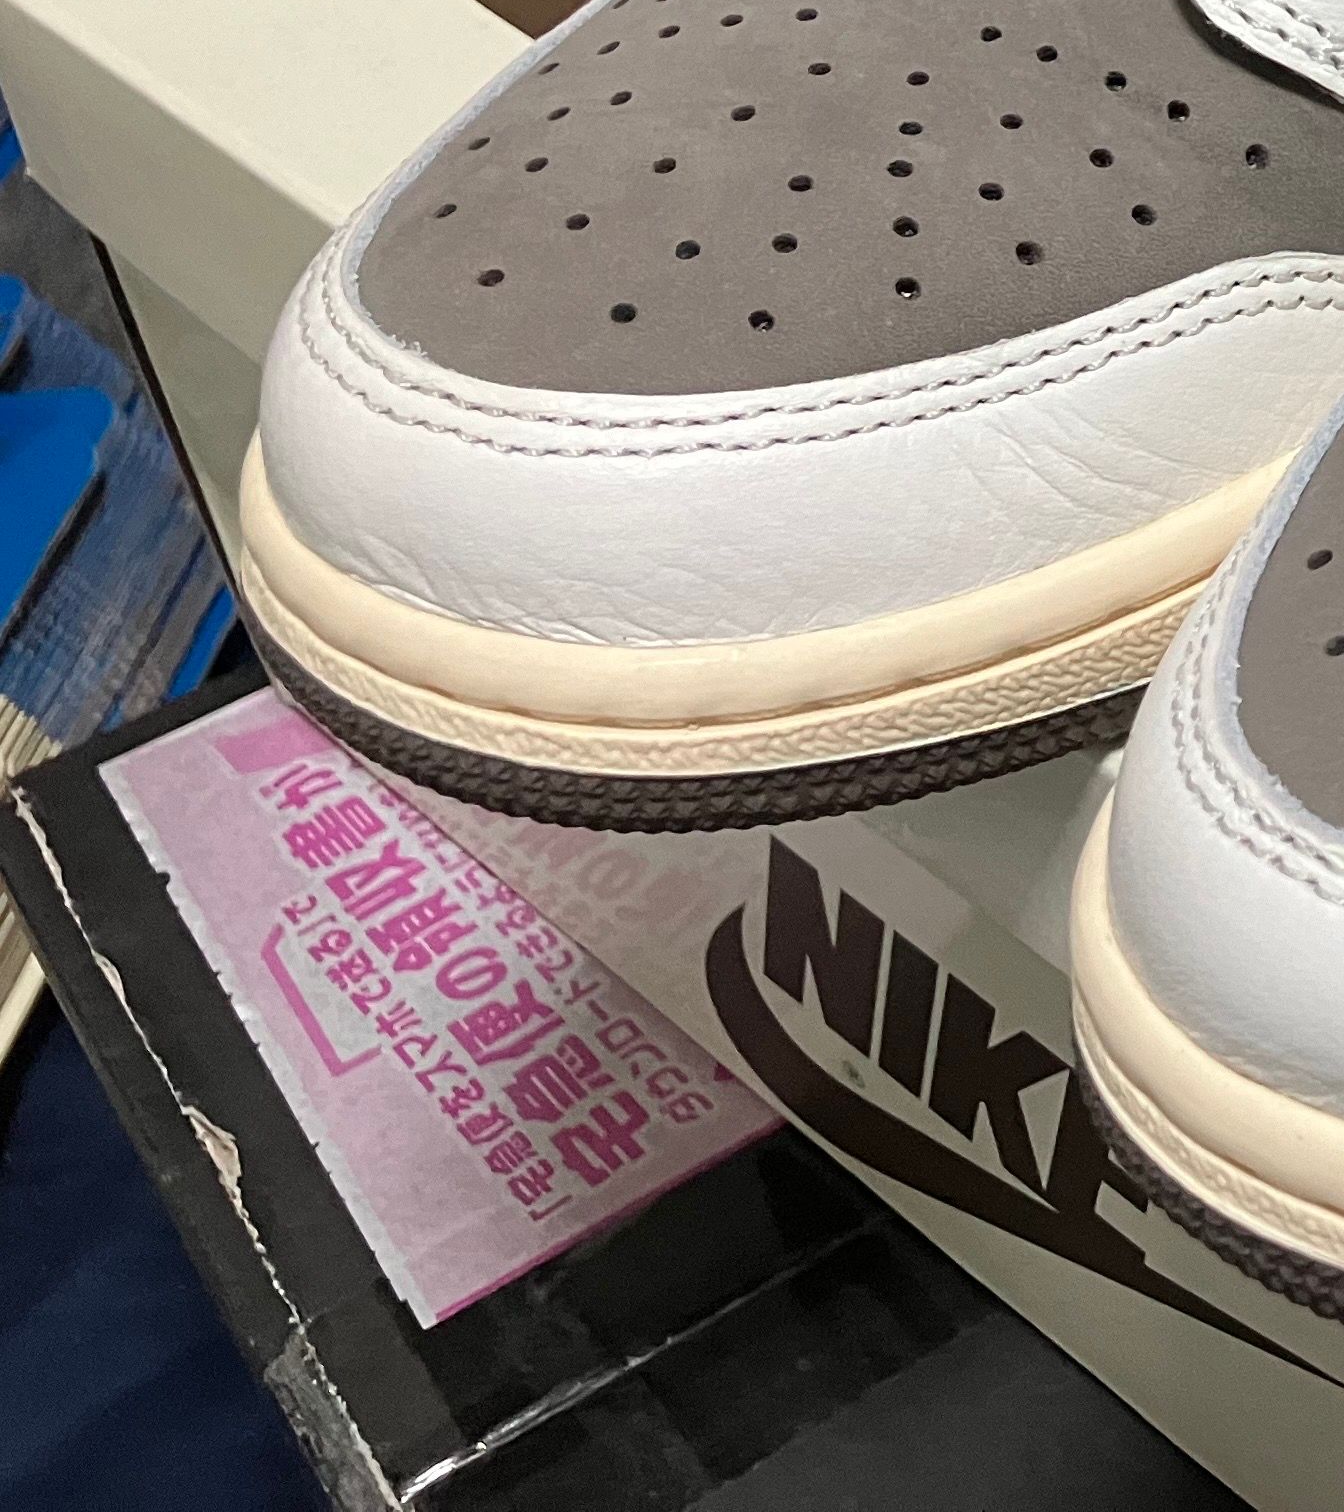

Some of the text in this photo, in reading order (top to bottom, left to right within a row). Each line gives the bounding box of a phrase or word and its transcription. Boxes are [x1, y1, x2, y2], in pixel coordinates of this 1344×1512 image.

[261, 764, 650, 1188] 宅急便の領収書が
